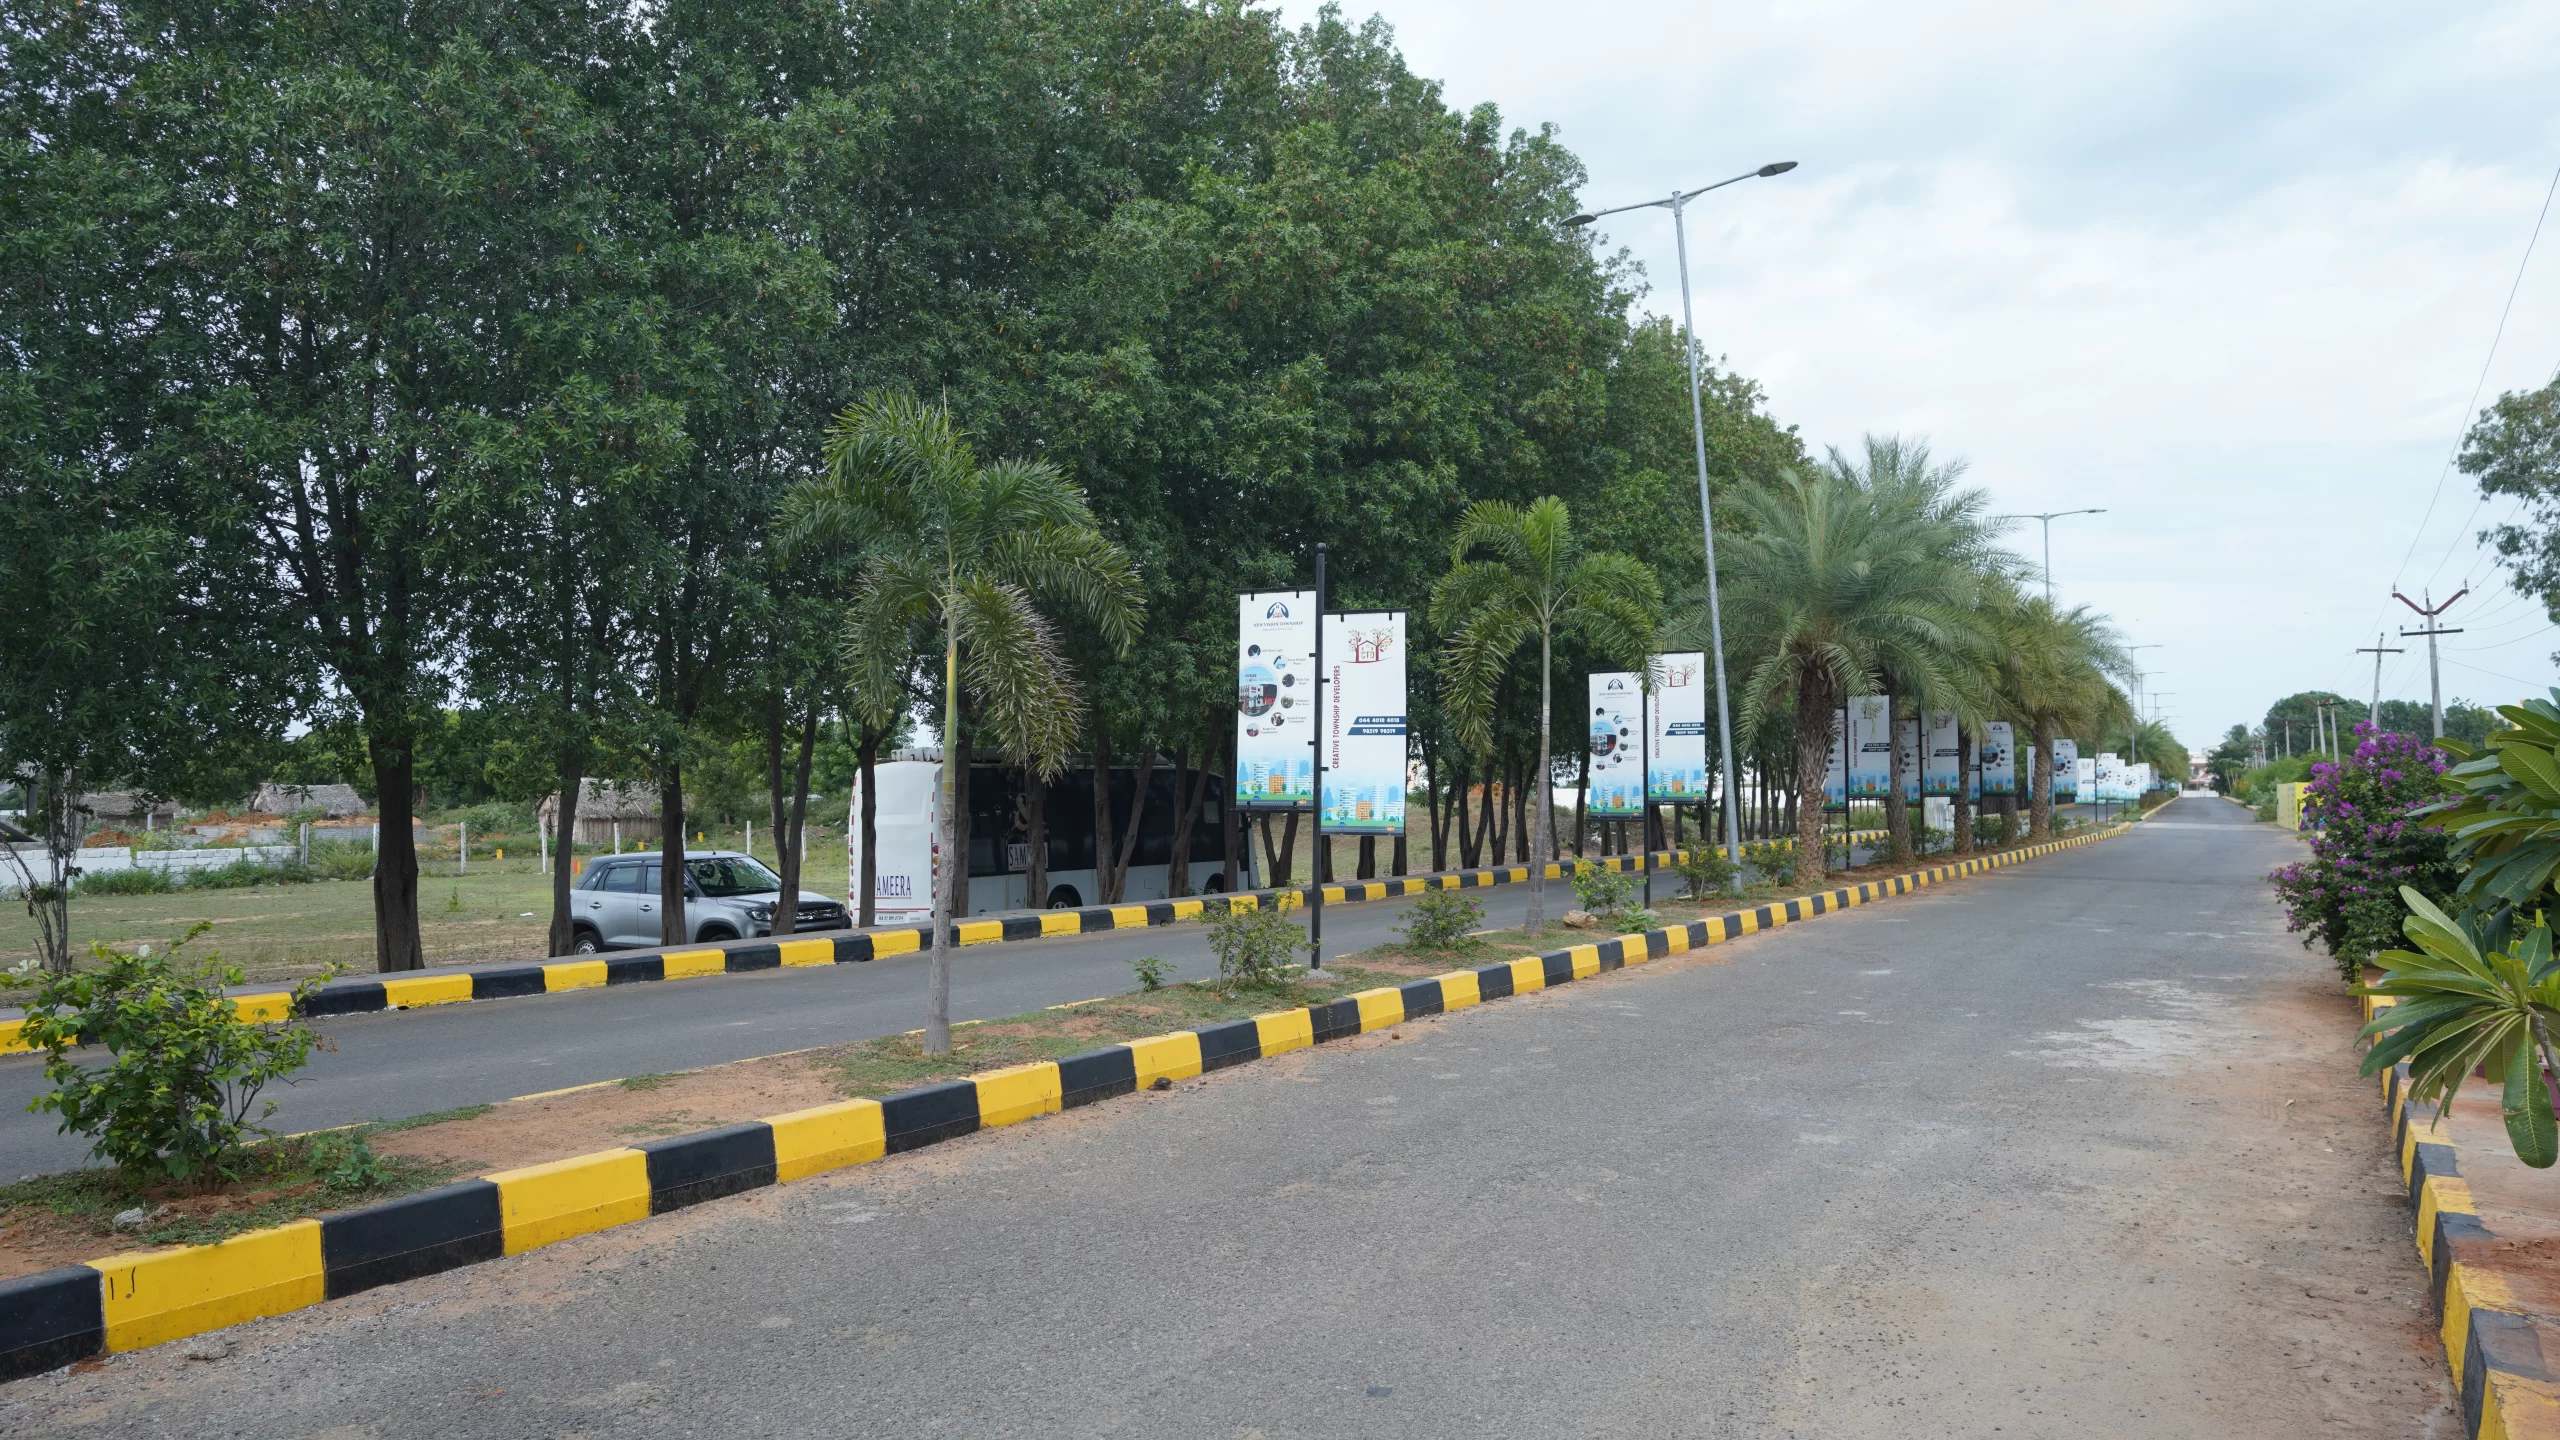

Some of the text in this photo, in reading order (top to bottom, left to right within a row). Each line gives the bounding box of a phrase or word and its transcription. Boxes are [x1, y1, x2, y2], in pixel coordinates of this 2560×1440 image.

[1333, 665, 1341, 703] DEVELOPERS
[1332, 740, 1340, 769] CREATIVE
[876, 875, 912, 896] AMEERA
